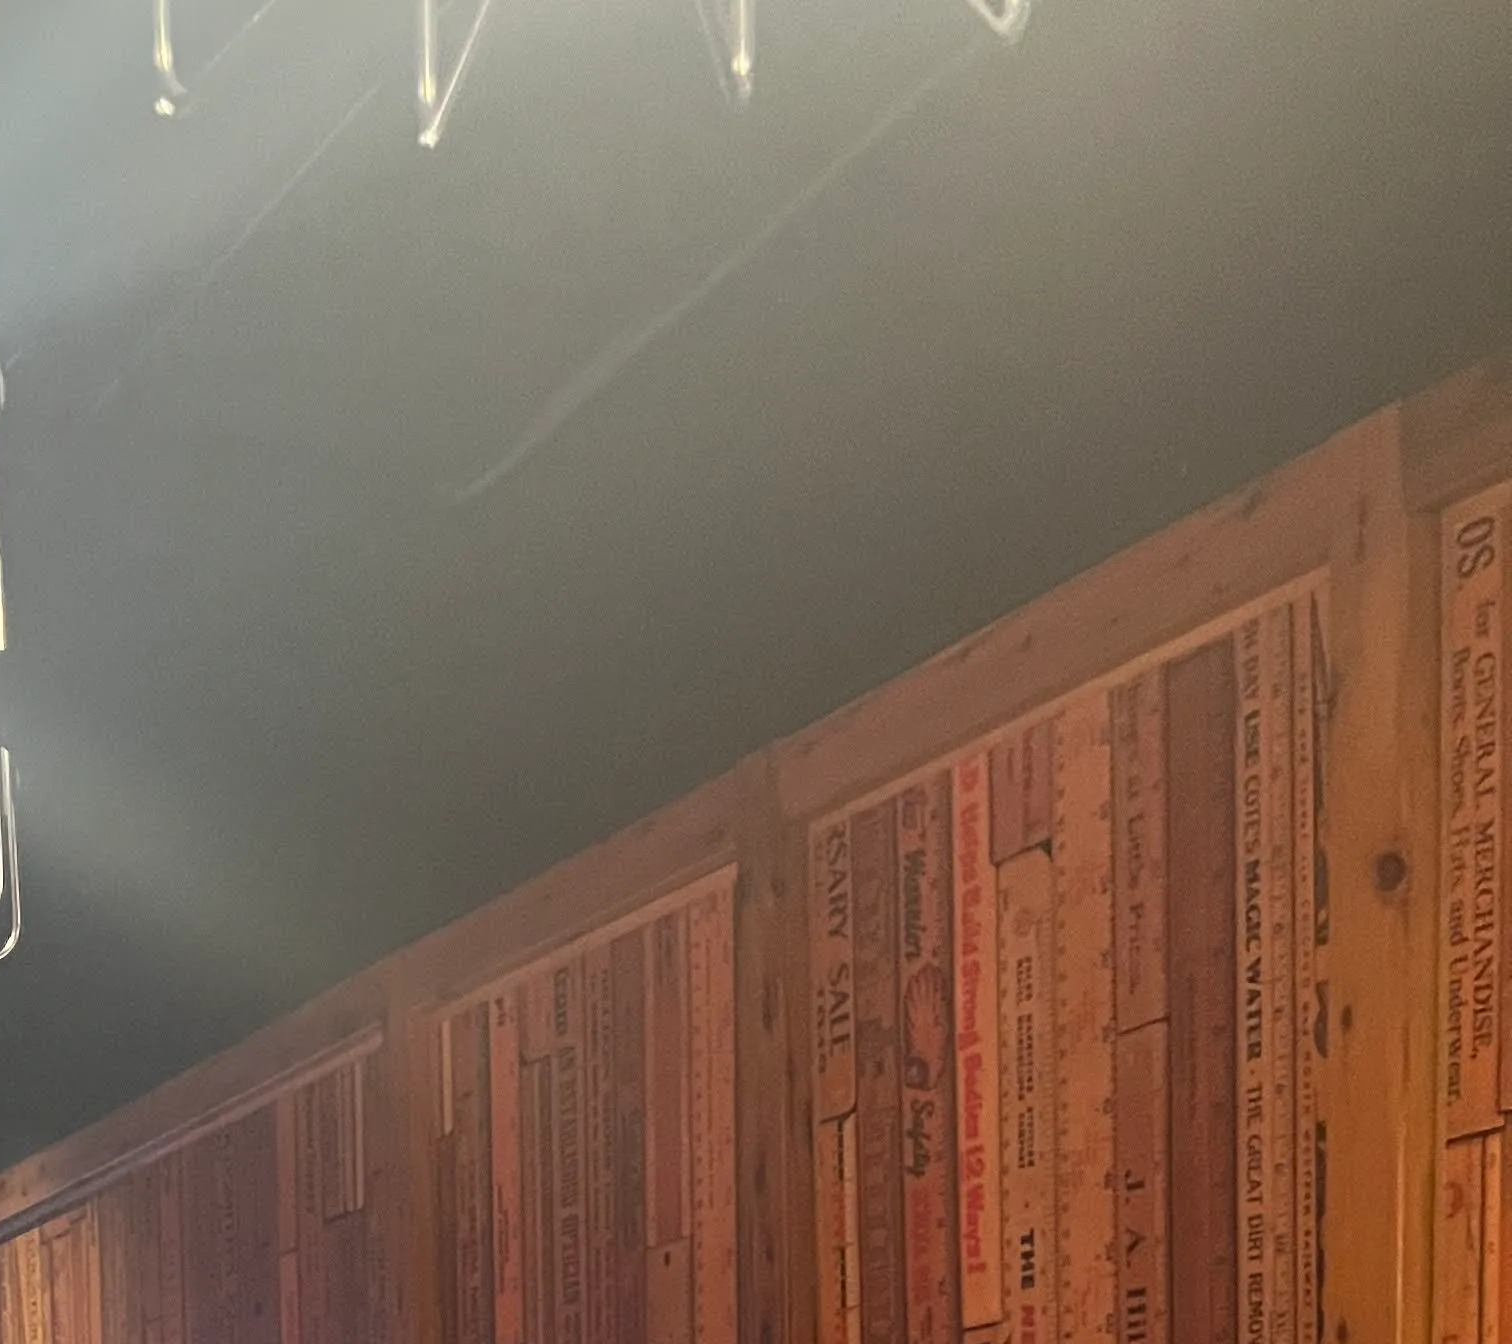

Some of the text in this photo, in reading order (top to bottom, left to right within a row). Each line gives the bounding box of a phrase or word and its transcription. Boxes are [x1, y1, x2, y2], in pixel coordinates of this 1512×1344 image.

[1244, 709, 1263, 768] USE
[1473, 652, 1498, 812] GENERAL
[961, 884, 982, 957] Build
[1246, 857, 1263, 952] MAGIC
[1448, 902, 1468, 947] and
[1470, 818, 1497, 1061] MERCHANDISE,
[828, 961, 851, 1057] SALE
[959, 959, 982, 1051] Strong
[1246, 956, 1264, 1062] WATER
[964, 1052, 983, 1140] Bodies
[1247, 1086, 1264, 1129] THE
[966, 1144, 987, 1180] 12
[1124, 1169, 1146, 1205] J.
[1247, 1134, 1264, 1206] GREAT
[964, 1182, 989, 1274] Ways!
[1021, 1229, 1036, 1291] THE
[1126, 1226, 1148, 1270] A.
[1247, 1214, 1264, 1263] DIRT
